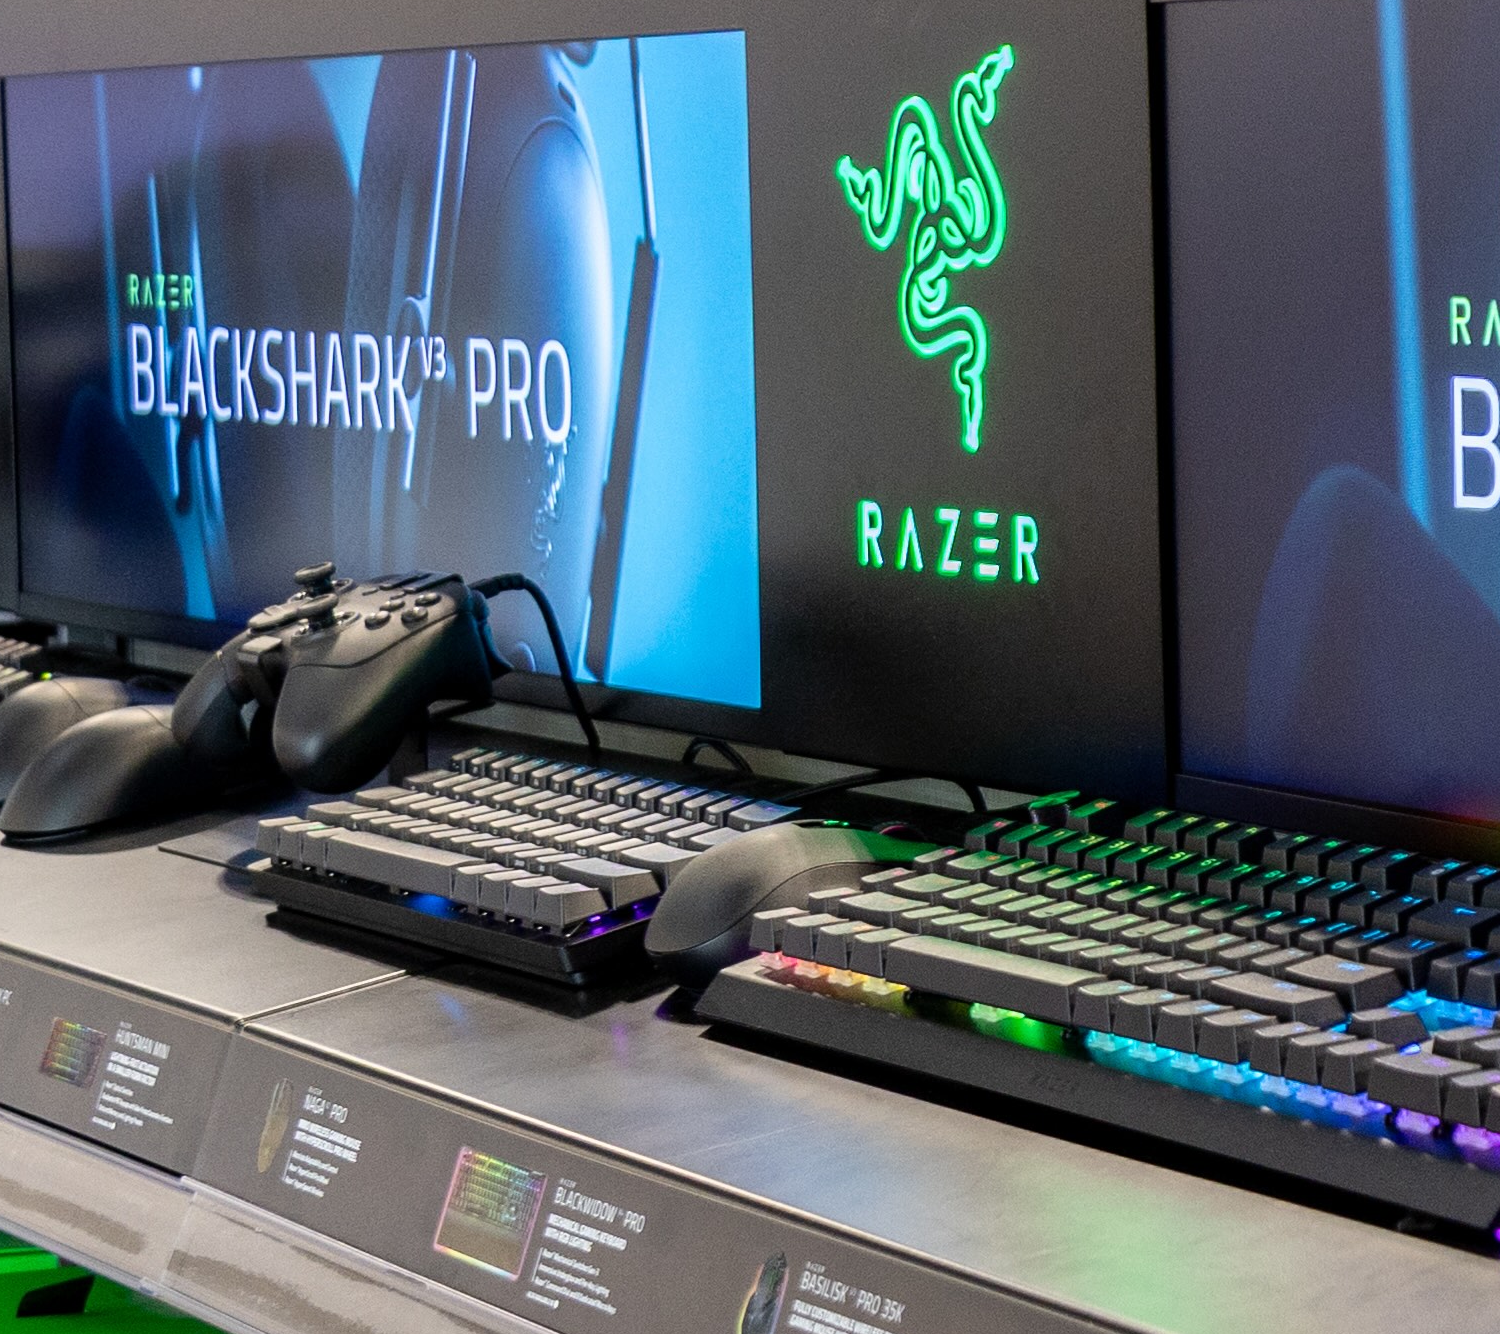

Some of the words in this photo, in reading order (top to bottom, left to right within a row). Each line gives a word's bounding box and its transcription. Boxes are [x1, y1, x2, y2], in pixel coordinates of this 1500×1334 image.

[125, 272, 196, 311] RAZER
[127, 322, 413, 435] BLACKSHARK
[464, 336, 574, 447] PRO
[855, 498, 1041, 585] RAZER
[329, 1103, 349, 1124] PRO
[554, 1186, 618, 1223] BLACKWIDOW
[623, 1210, 646, 1233] PRO
[801, 1270, 850, 1304] BASILISK
[856, 1289, 882, 1315] PRO
[881, 1298, 906, 1324] 35K
